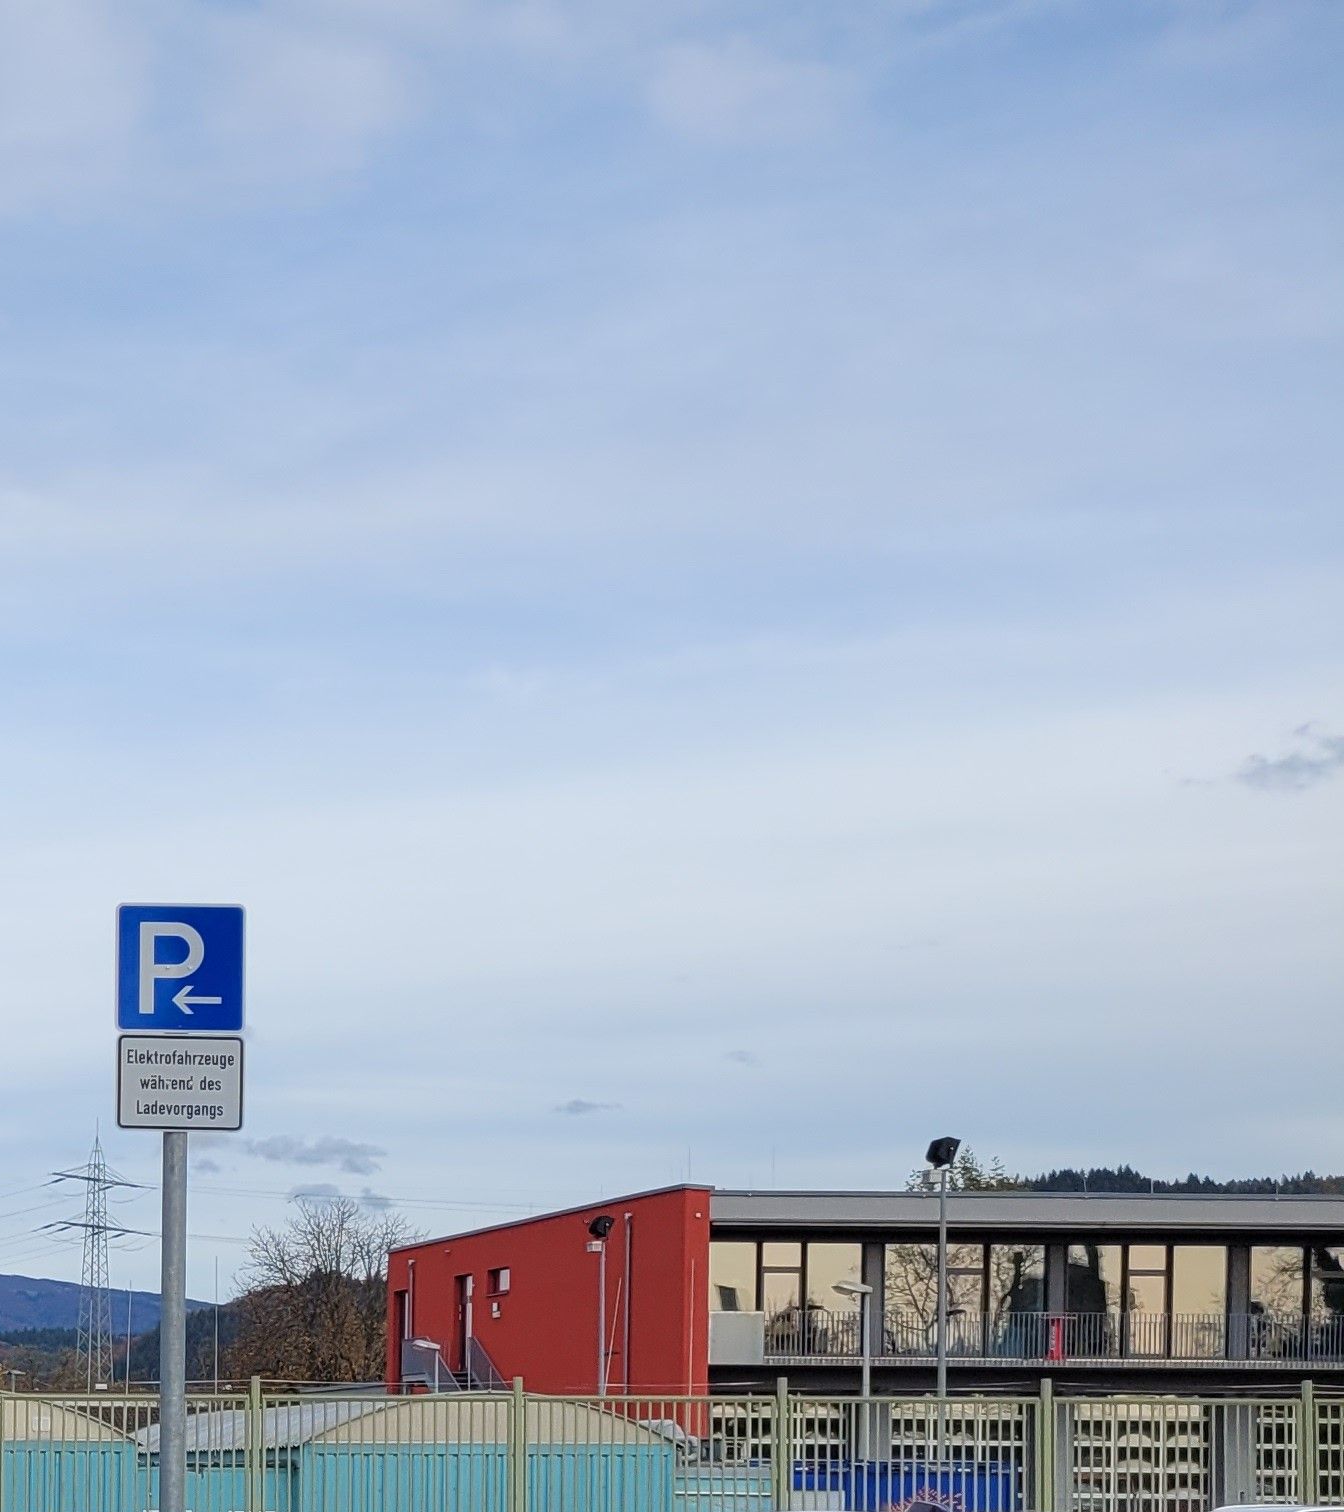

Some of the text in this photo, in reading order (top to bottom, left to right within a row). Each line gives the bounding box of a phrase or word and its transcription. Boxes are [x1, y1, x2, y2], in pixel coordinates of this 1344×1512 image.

[138, 921, 205, 1014] P
[126, 1049, 235, 1069] Elektrofahrzeuge
[139, 1075, 222, 1091] während des
[136, 1100, 224, 1120] Ladevorgangs
